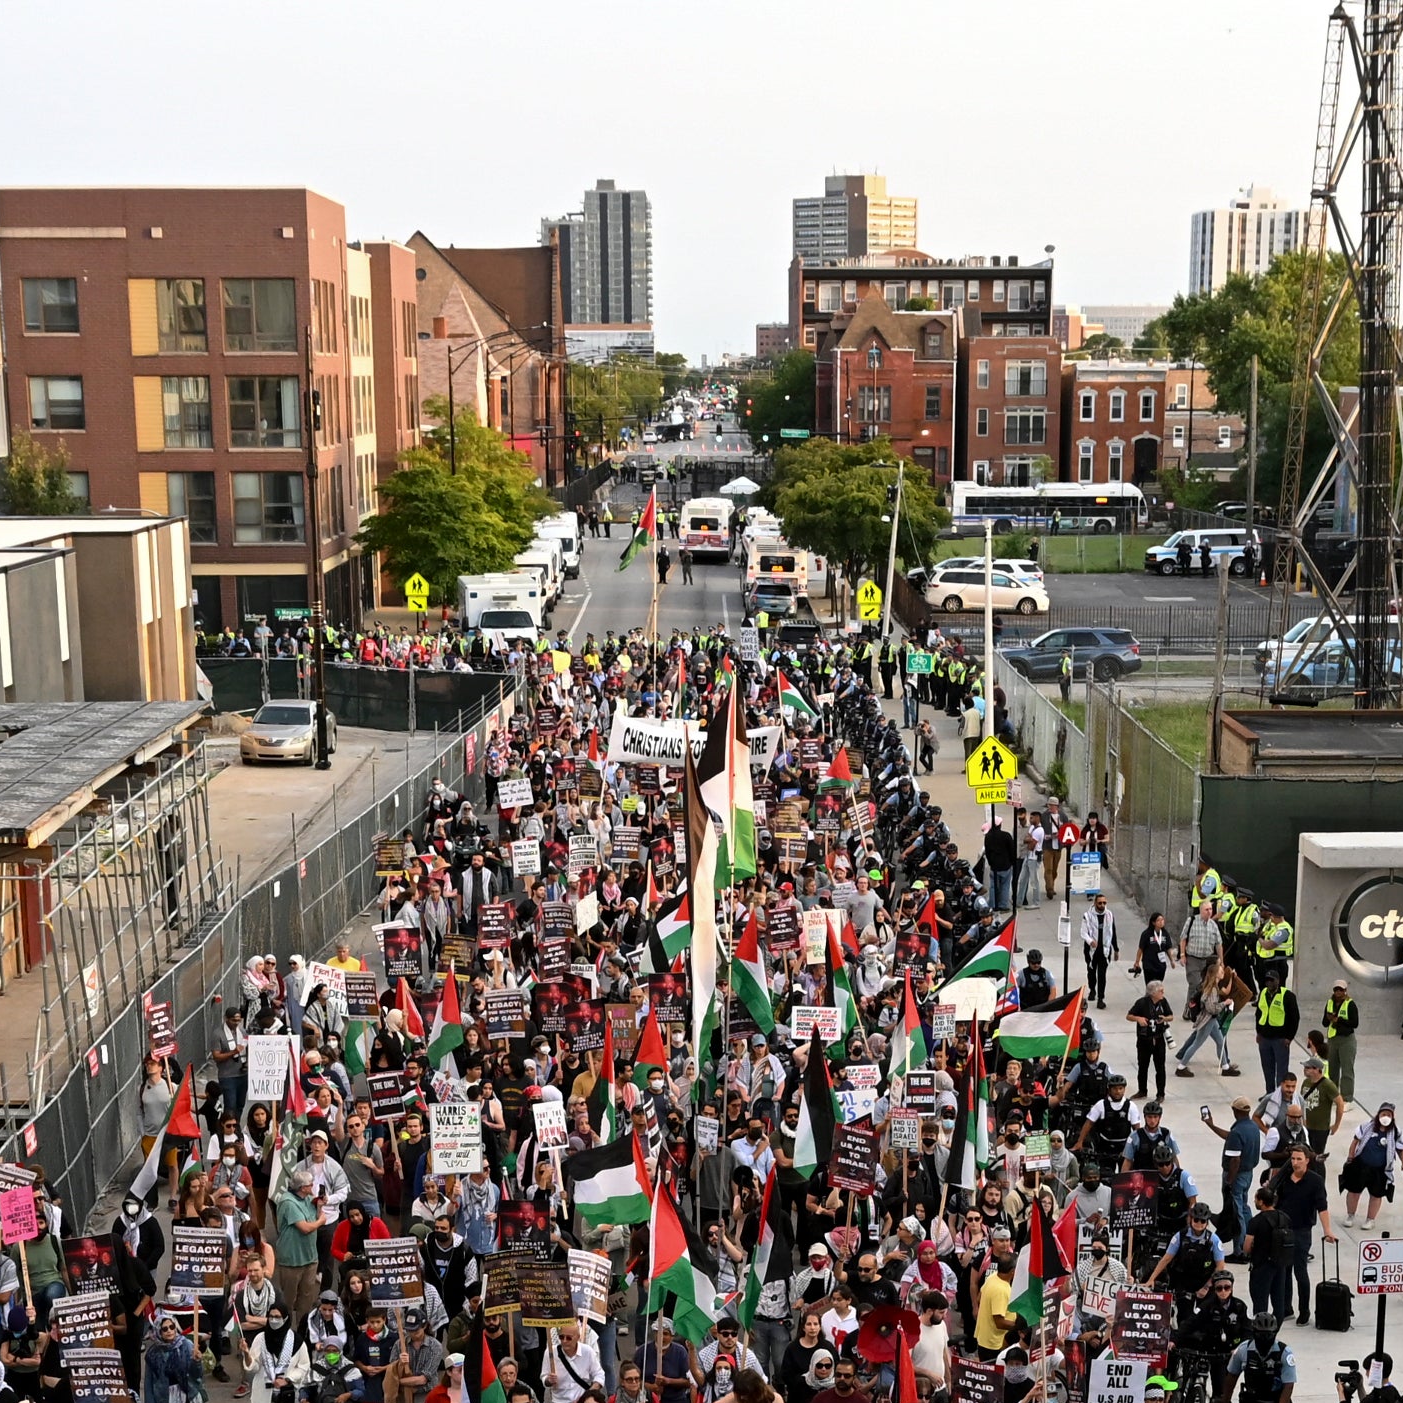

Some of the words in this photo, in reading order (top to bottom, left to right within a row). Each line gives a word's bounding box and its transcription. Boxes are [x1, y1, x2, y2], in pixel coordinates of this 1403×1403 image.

[623, 727, 682, 759] CHRISTIANS
[980, 791, 1006, 800] AHEAD
[1062, 829, 1076, 843] A
[252, 1079, 270, 1094] WAR
[436, 1106, 466, 1116] HARRIS
[436, 1117, 463, 1125] WALZ
[1382, 1265, 1403, 1273] BUS
[1107, 1364, 1132, 1376] END
[1107, 1377, 1129, 1388] ALL
[1117, 1395, 1134, 1403] AID
